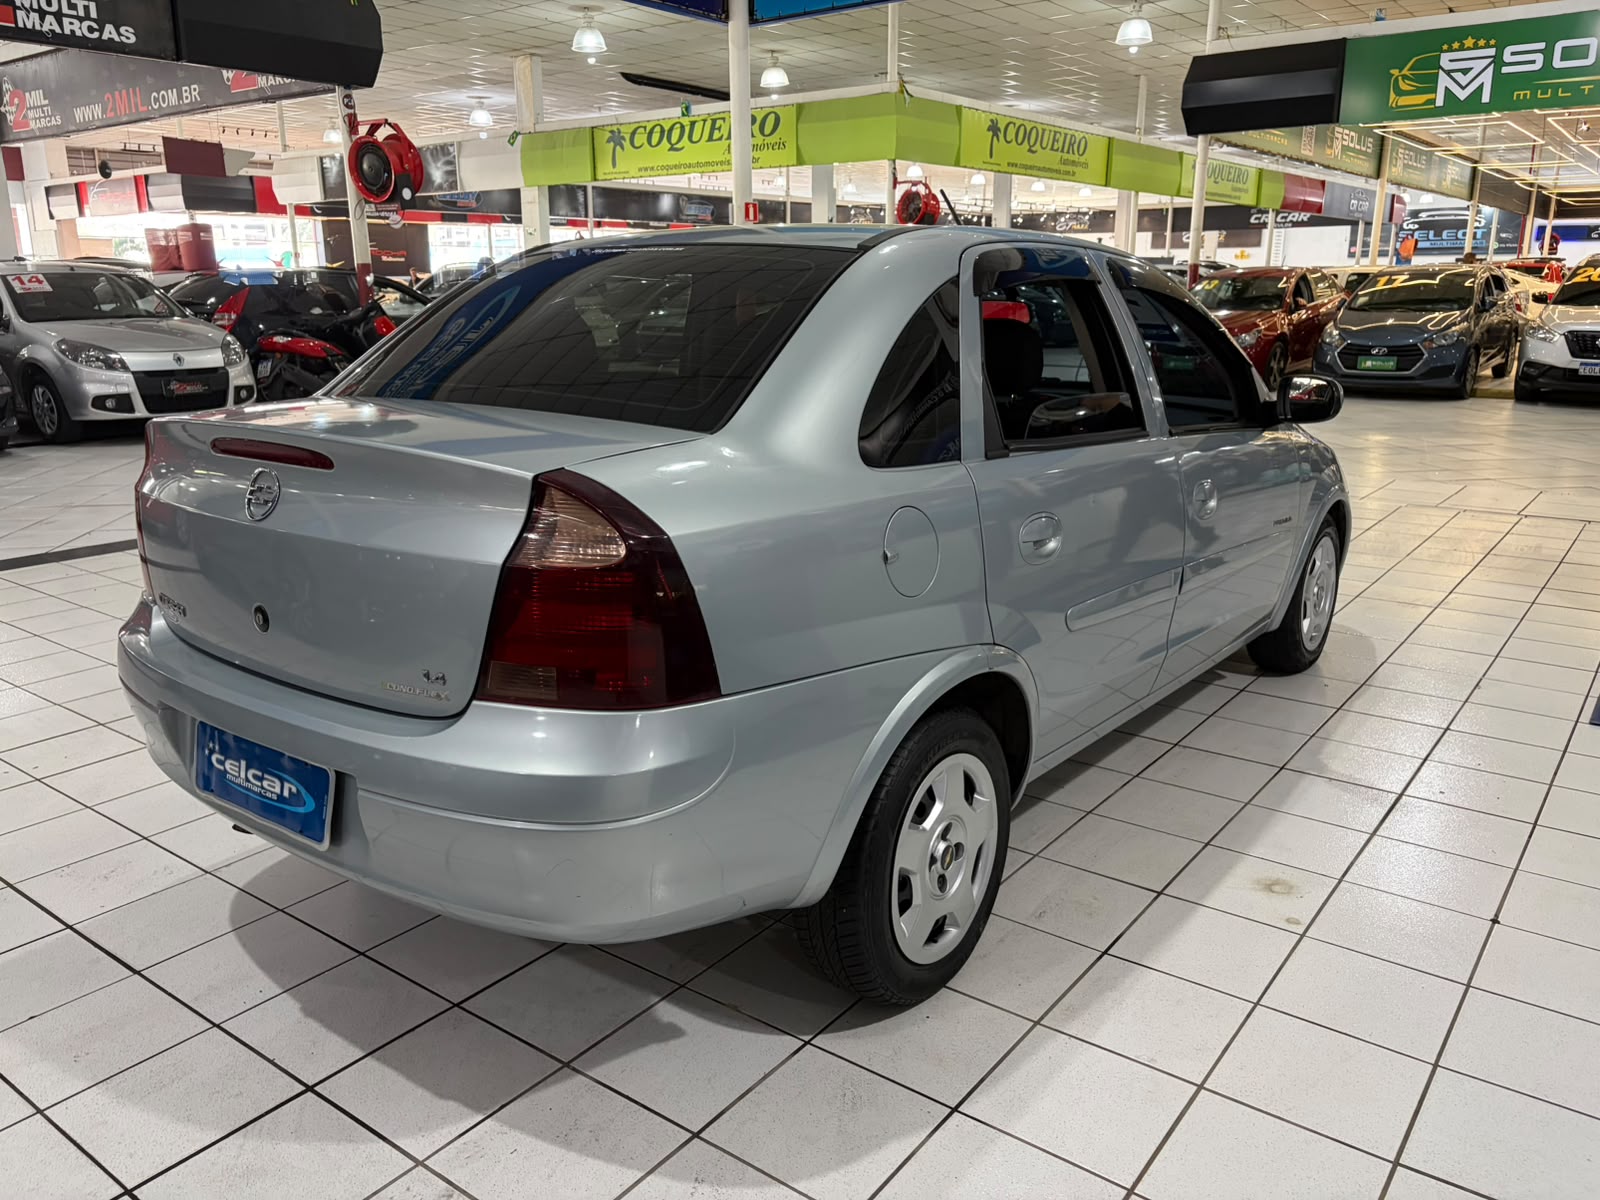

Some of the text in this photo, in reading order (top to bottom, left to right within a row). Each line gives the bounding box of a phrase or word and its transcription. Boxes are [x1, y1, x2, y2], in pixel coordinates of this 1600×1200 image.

[16, 10, 137, 44] MARCAS
[1501, 37, 1598, 74] SO
[25, 89, 49, 108] MIL
[73, 84, 201, 123] WWW.2MIL.COM.BR
[1513, 84, 1595, 101] MULT
[28, 106, 52, 119] MULTI
[30, 115, 62, 129] MARCAS
[1003, 121, 1088, 157] COQUEIRO
[1342, 128, 1374, 153] SOLUS
[1207, 161, 1249, 185] OQUEIRO
[1276, 212, 1312, 223] CAR
[10, 274, 44, 287] 14
[1375, 274, 1410, 289] 17
[211, 752, 298, 799] celcar
[226, 773, 279, 801] multimarcas
